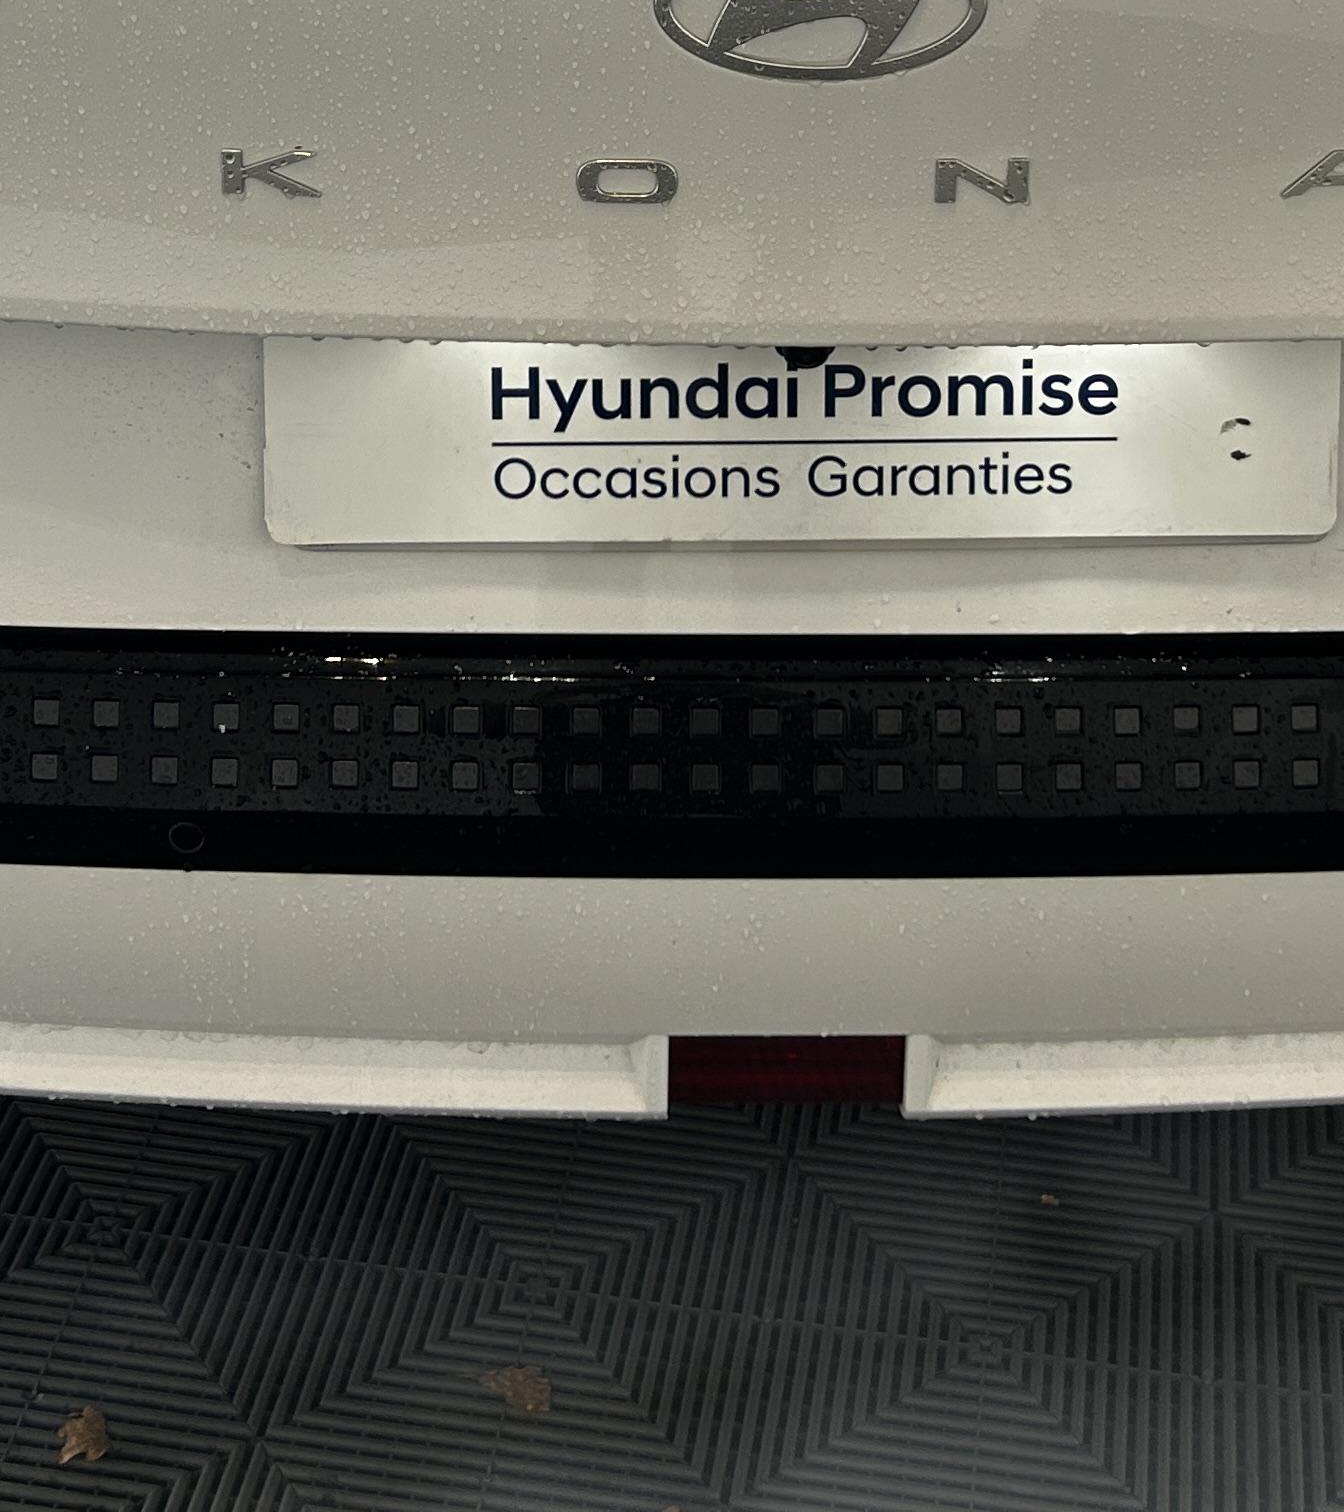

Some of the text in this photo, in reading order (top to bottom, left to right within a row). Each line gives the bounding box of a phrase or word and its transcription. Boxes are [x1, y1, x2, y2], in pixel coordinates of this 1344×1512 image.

[491, 358, 1119, 433] Hyundai Promise
[494, 451, 1073, 500] Occasions Garanties
